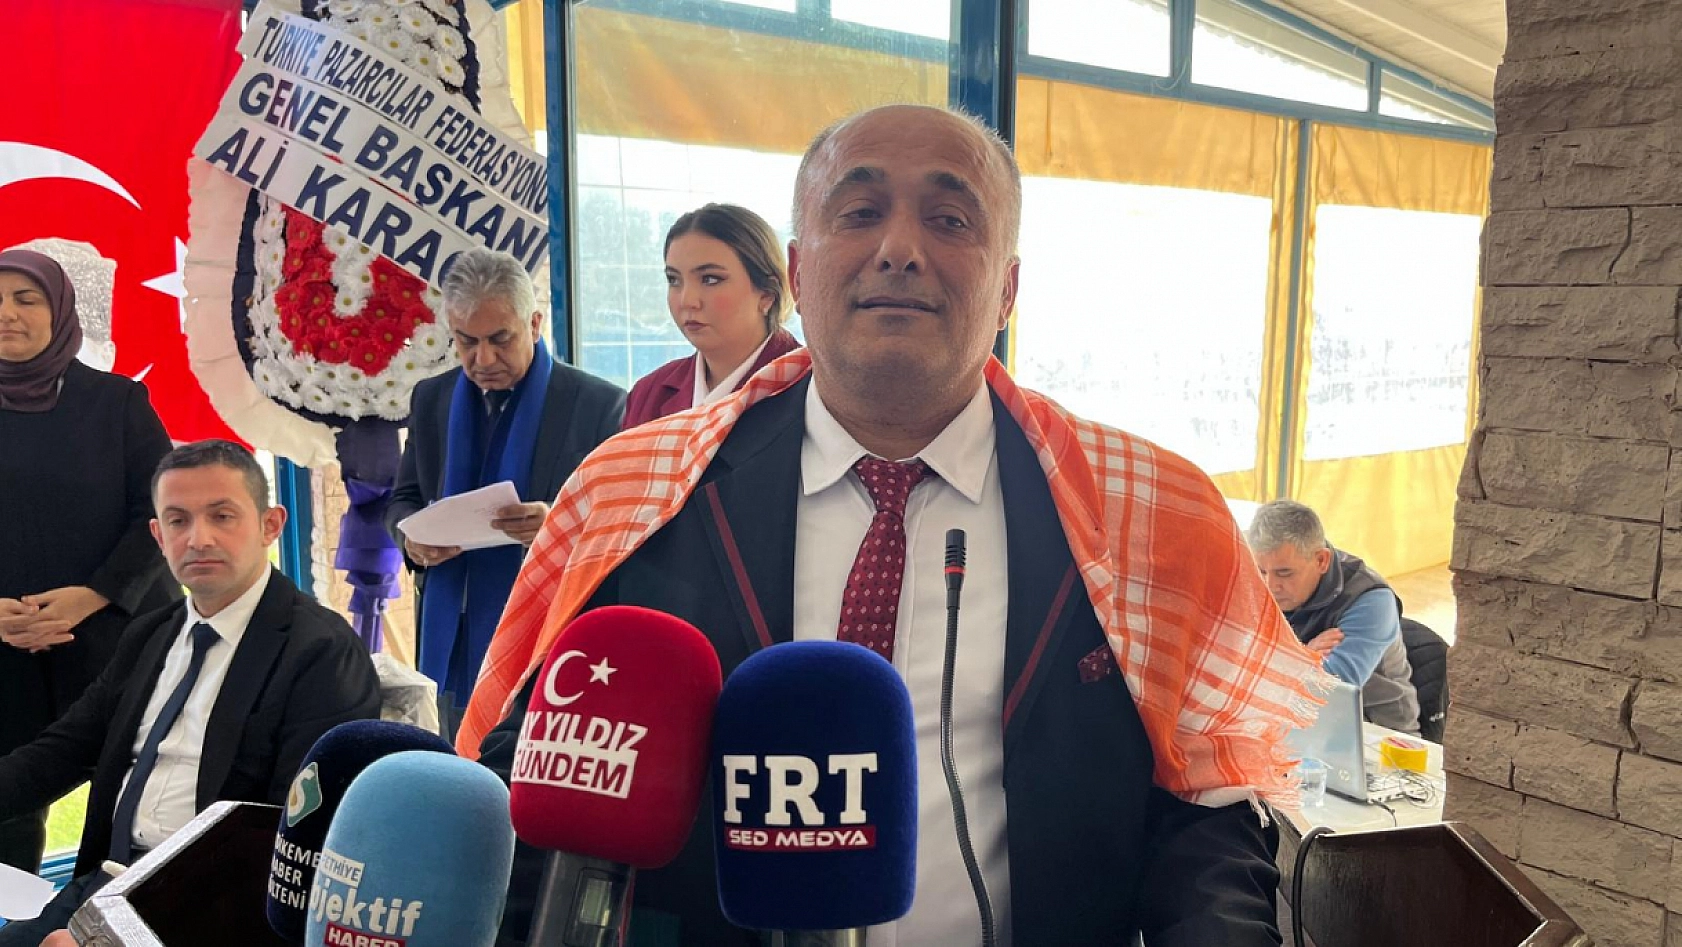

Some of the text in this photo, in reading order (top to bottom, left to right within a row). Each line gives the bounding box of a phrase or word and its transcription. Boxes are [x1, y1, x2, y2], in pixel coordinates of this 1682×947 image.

[253, 15, 326, 77] TÜRKİYE
[315, 40, 435, 131] PAZARCILAR
[206, 126, 289, 190] ALİ
[239, 73, 549, 273] GENEL BAŞKANI
[543, 711, 648, 752] YILDIZ
[723, 752, 878, 826] FRT
[729, 829, 868, 847] SED MEDYA
